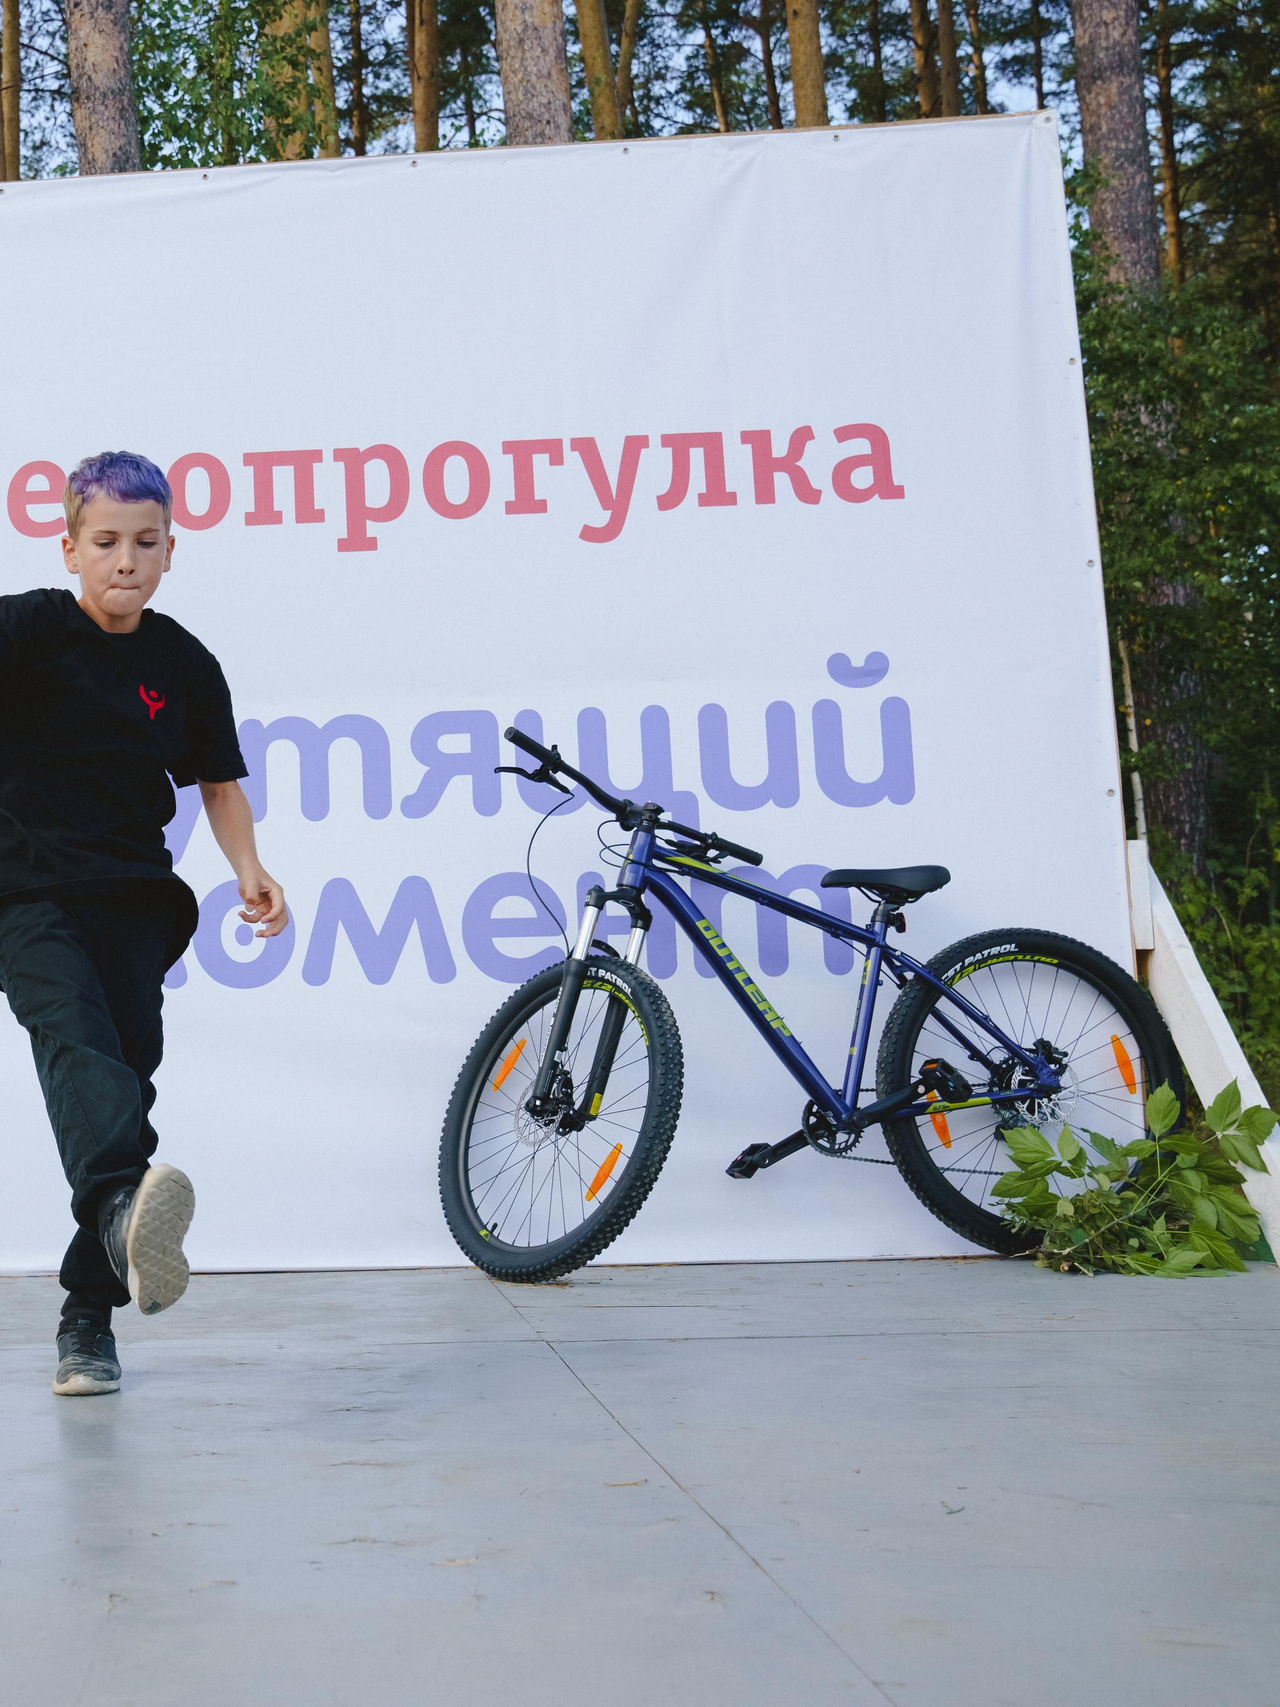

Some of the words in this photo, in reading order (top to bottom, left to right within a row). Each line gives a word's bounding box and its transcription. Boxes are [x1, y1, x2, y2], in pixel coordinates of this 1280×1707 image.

[163, 864, 855, 990] омент
[695, 918, 793, 1037] OUTLEAP
[964, 943, 1019, 968] PATROL
